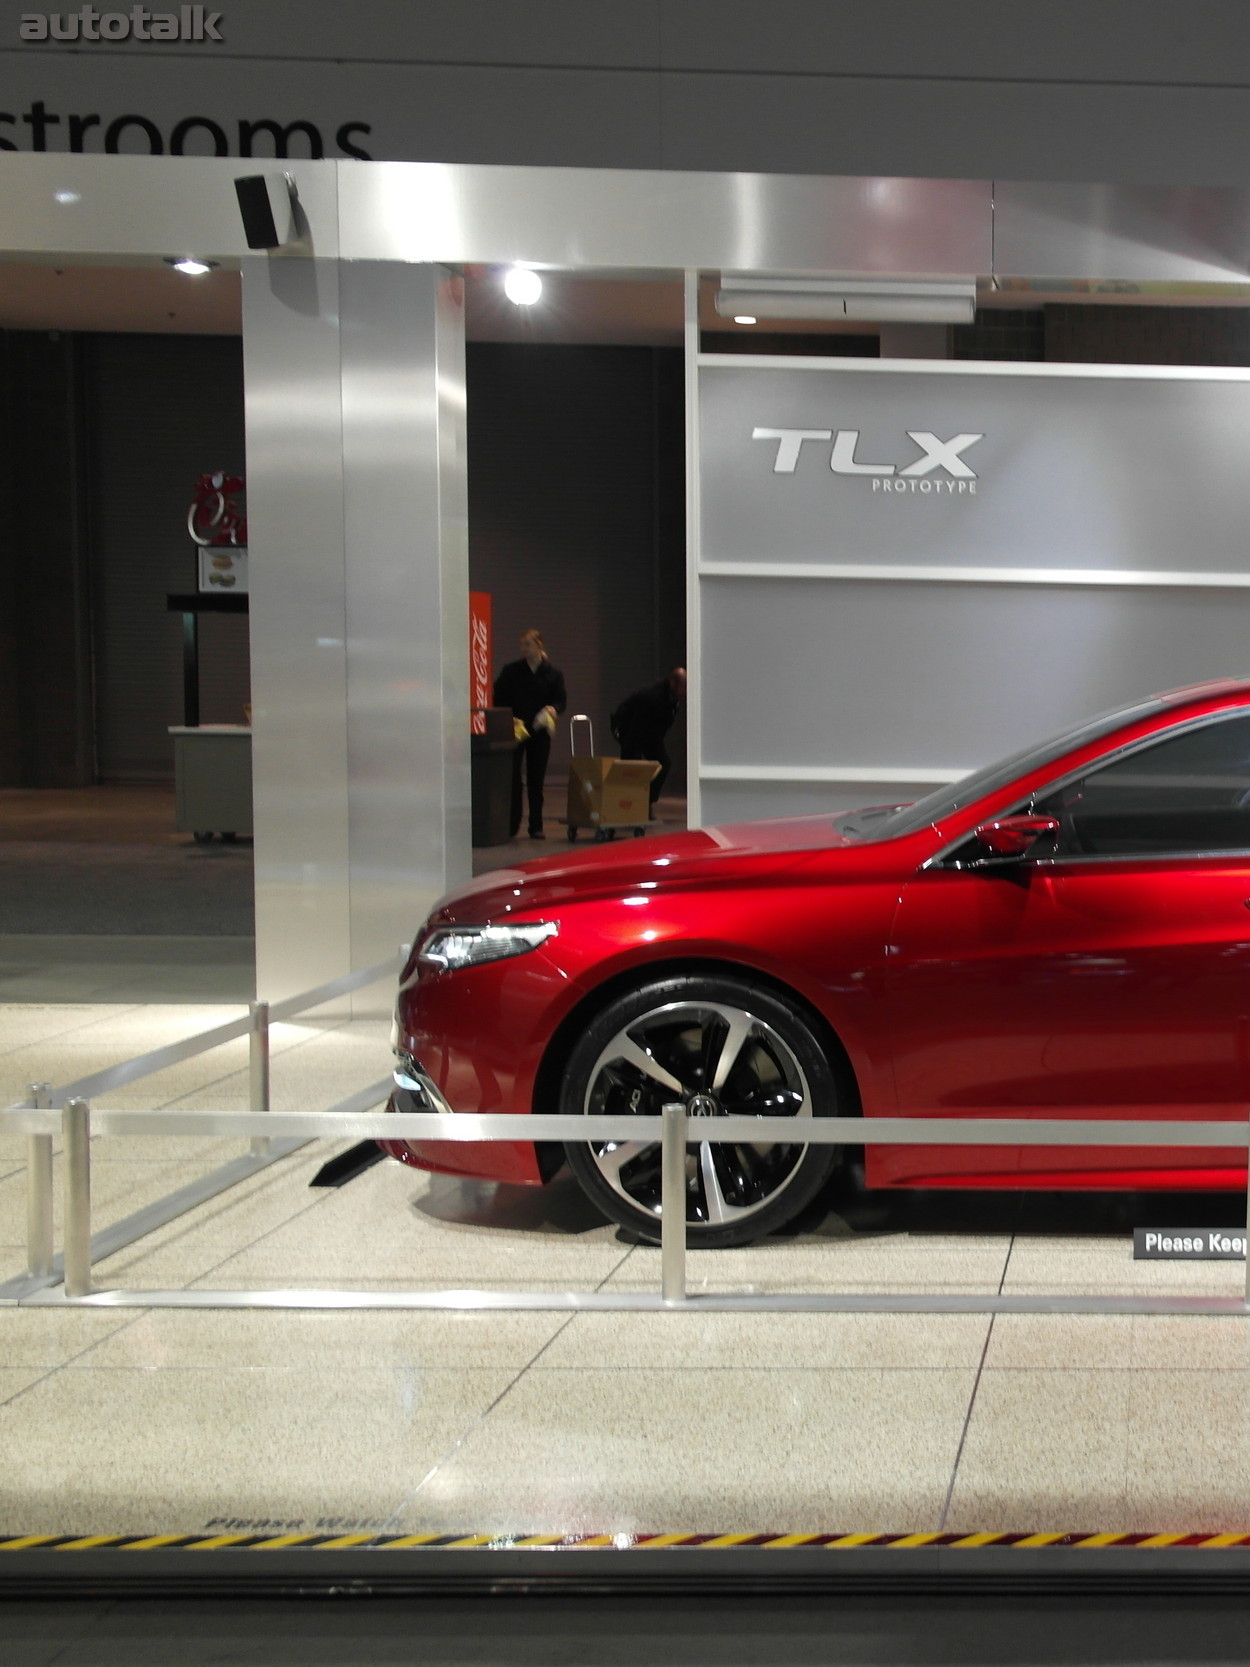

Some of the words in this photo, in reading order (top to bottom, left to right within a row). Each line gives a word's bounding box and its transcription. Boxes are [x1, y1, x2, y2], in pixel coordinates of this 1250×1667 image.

[752, 427, 986, 478] TLX
[872, 479, 977, 495] PROTOTYPE
[1145, 1232, 1204, 1252] Please
[204, 1516, 304, 1530] Please
[316, 1516, 405, 1530] Watch
